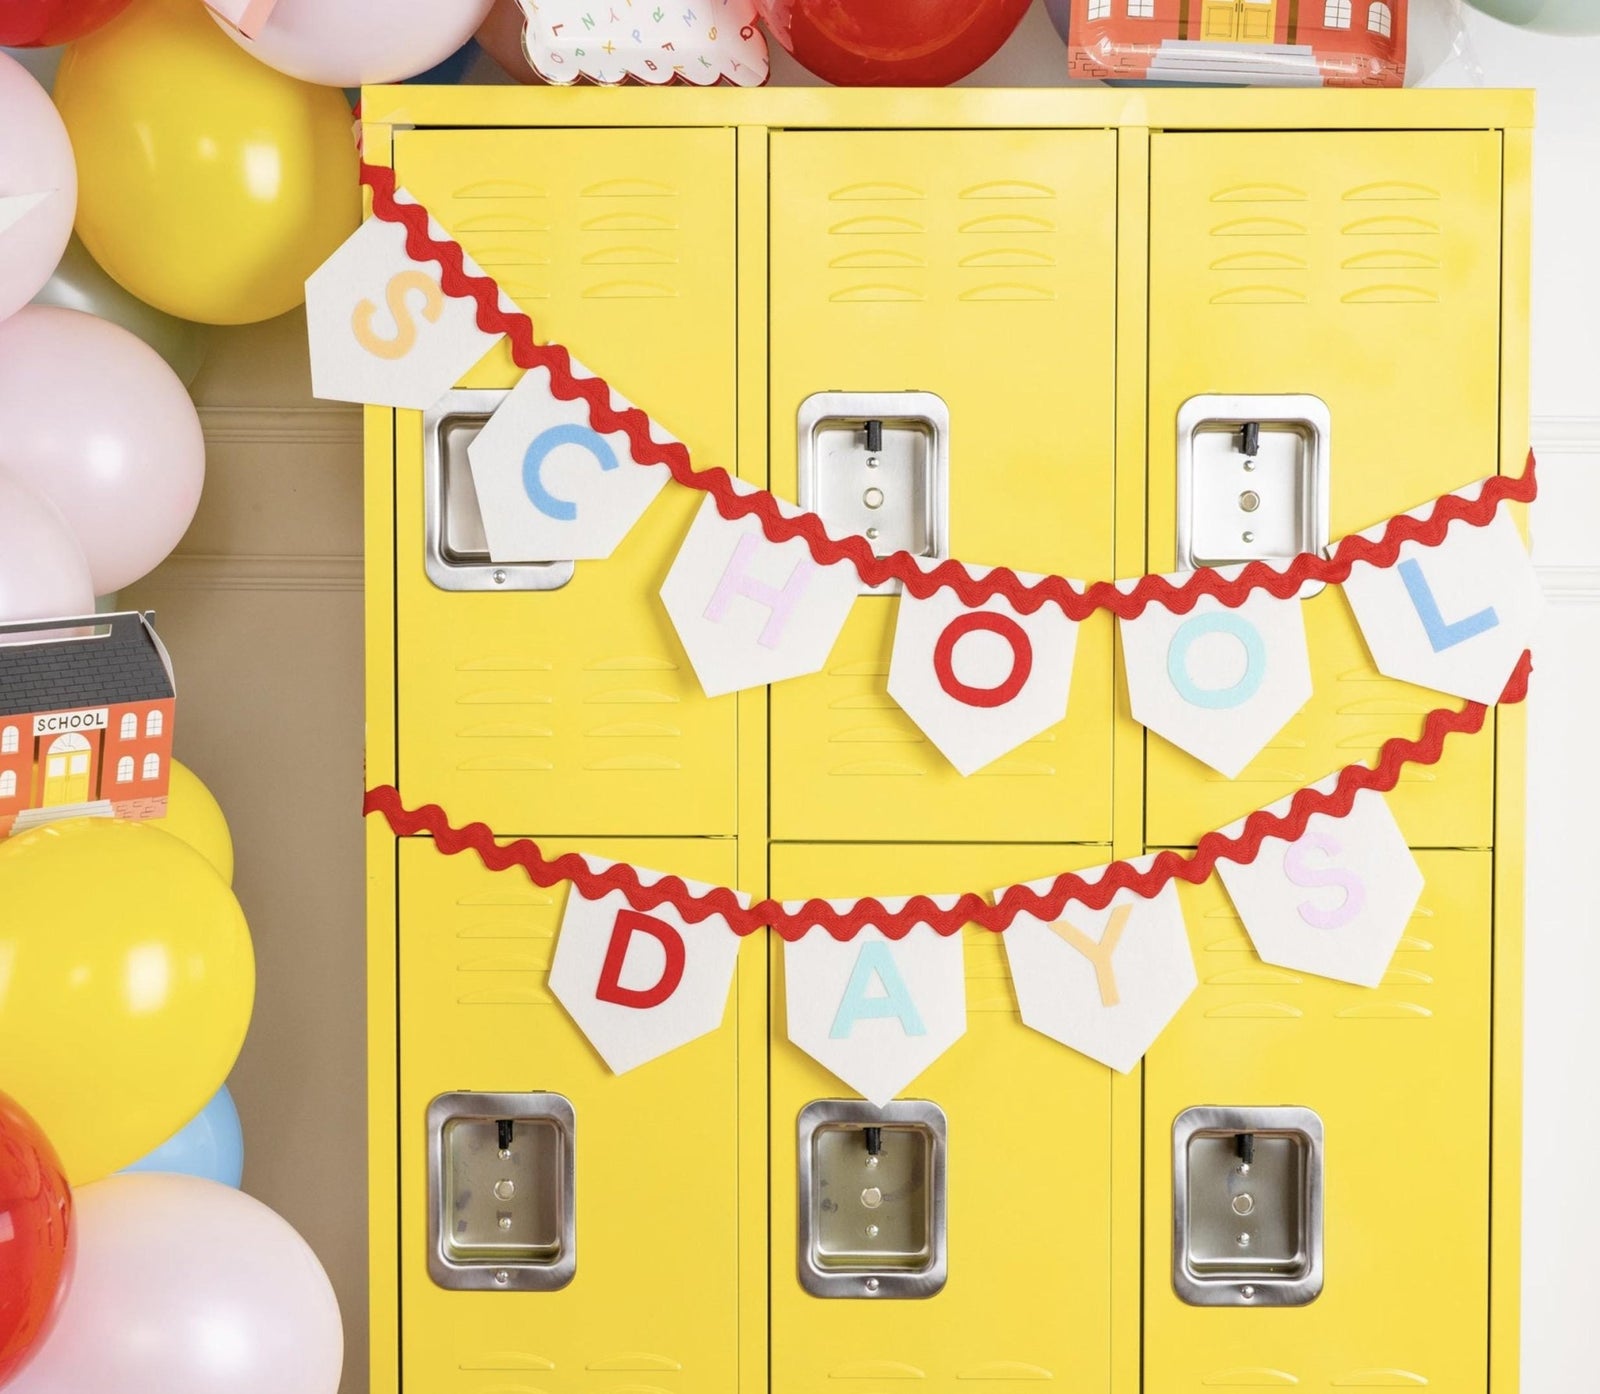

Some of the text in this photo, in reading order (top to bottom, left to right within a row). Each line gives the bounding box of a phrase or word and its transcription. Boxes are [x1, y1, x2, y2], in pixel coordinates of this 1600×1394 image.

[551, 23, 564, 37] L
[631, 28, 643, 44] P
[708, 26, 718, 41] S
[740, 25, 754, 42] Q
[661, 42, 676, 52] F
[644, 59, 658, 71] B
[351, 269, 1500, 709] SCHOOL
[37, 712, 104, 732] SCHOOL
[595, 831, 1366, 1040] DAYS
